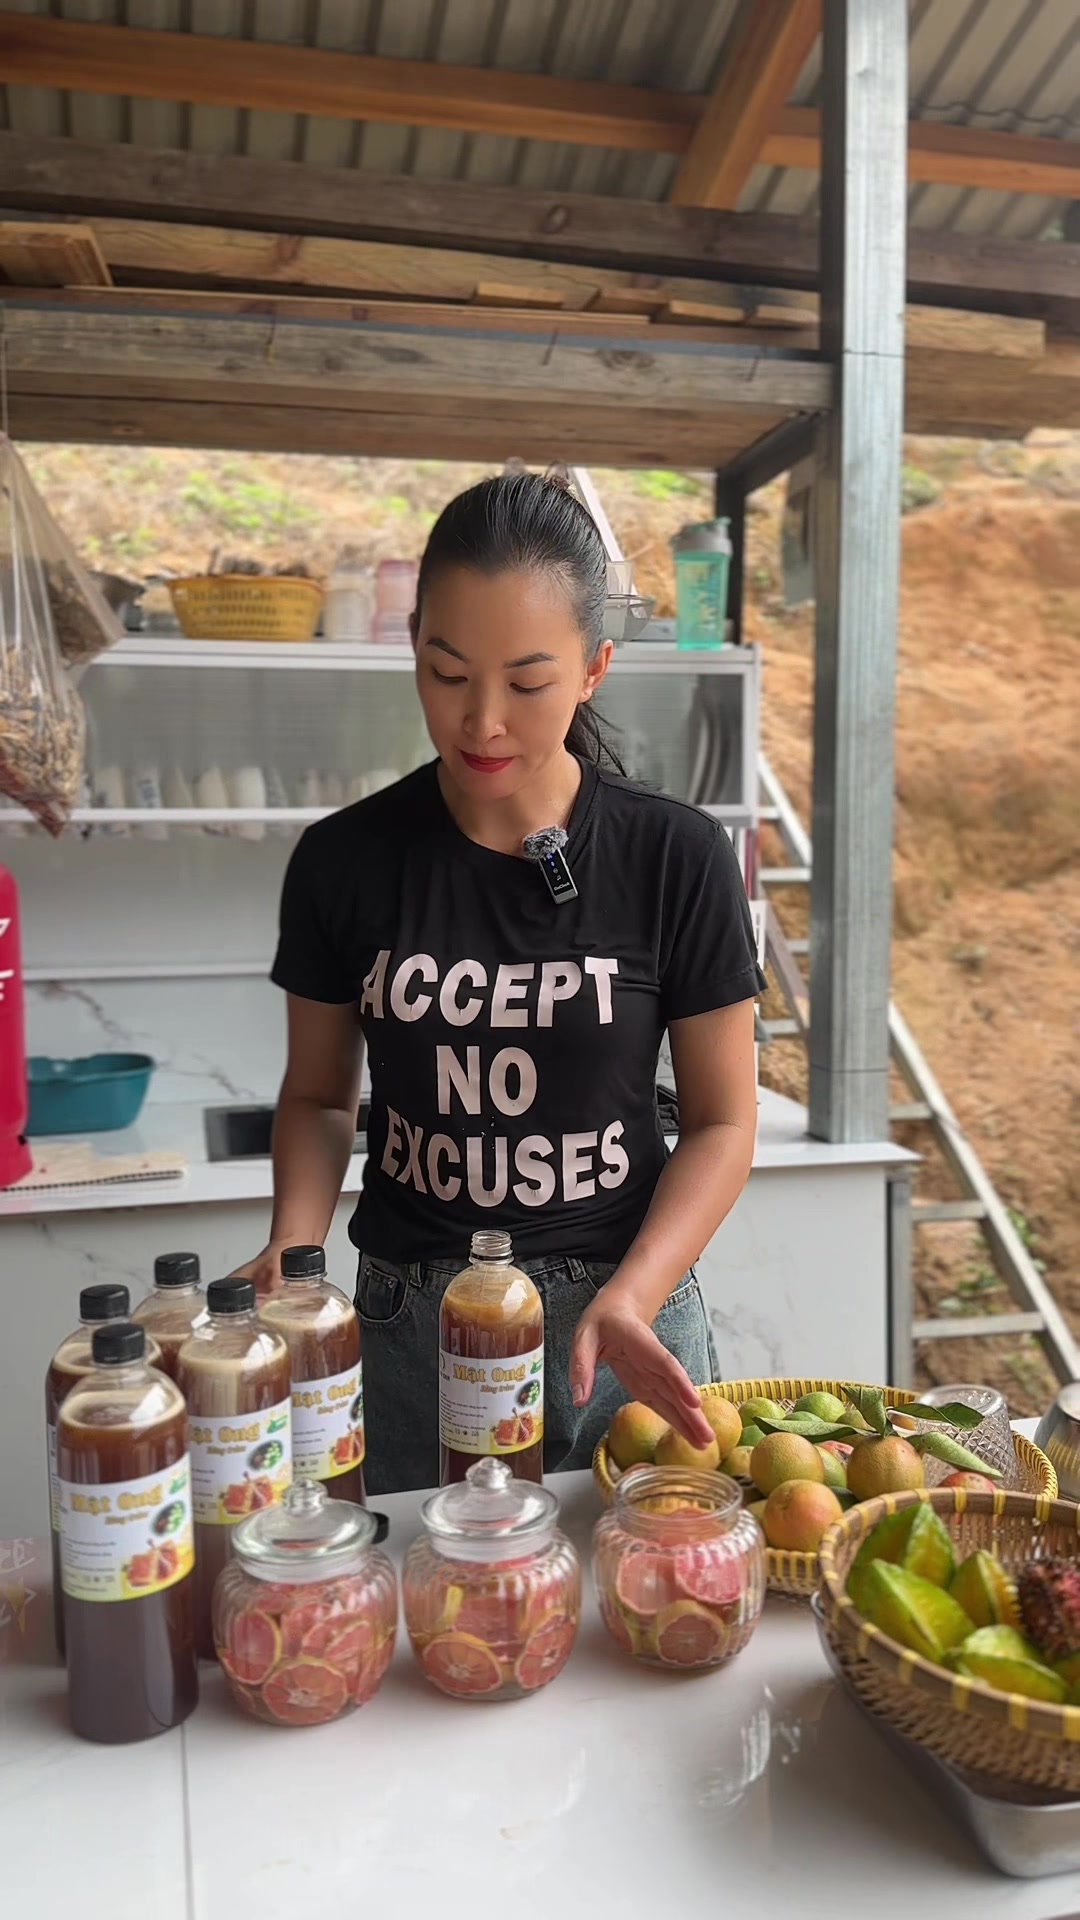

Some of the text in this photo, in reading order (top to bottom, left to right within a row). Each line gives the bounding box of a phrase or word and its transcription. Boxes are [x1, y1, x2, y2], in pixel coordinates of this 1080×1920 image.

[360, 950, 619, 1028] ACCEPT
[436, 1045, 538, 1117] NO
[380, 1105, 630, 1208] EXCUSES
[453, 1363, 487, 1384] Mật
[491, 1363, 526, 1382] Ong
